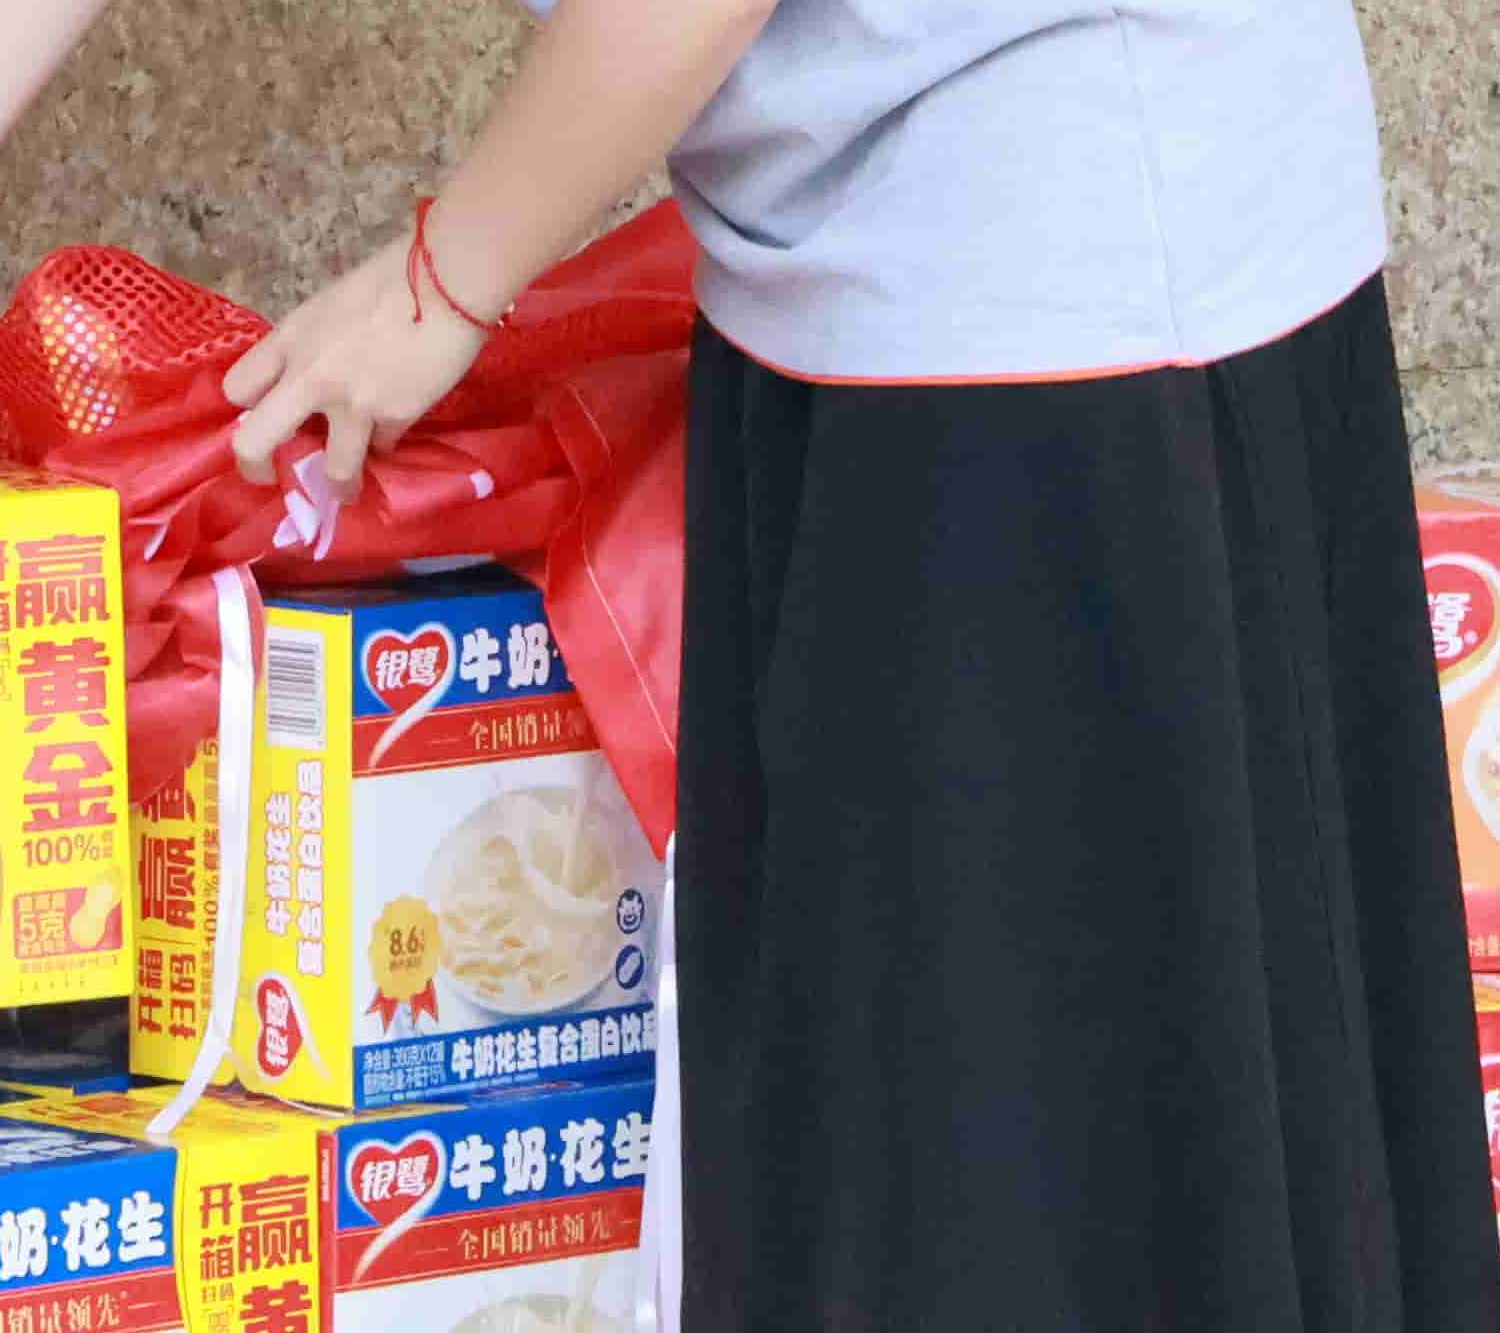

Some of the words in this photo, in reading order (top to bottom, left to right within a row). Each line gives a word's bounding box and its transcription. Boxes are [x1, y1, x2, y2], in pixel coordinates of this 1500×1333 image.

[15, 534, 117, 832] 赢黄金
[375, 645, 440, 691] 银鹭
[264, 790, 293, 937] 牛奶花生
[138, 948, 164, 1034] 开箱
[167, 952, 197, 1040] 扫码
[265, 991, 291, 1068] 银鹭
[360, 1153, 429, 1203] 银鹭
[200, 1182, 234, 1281] 开箱
